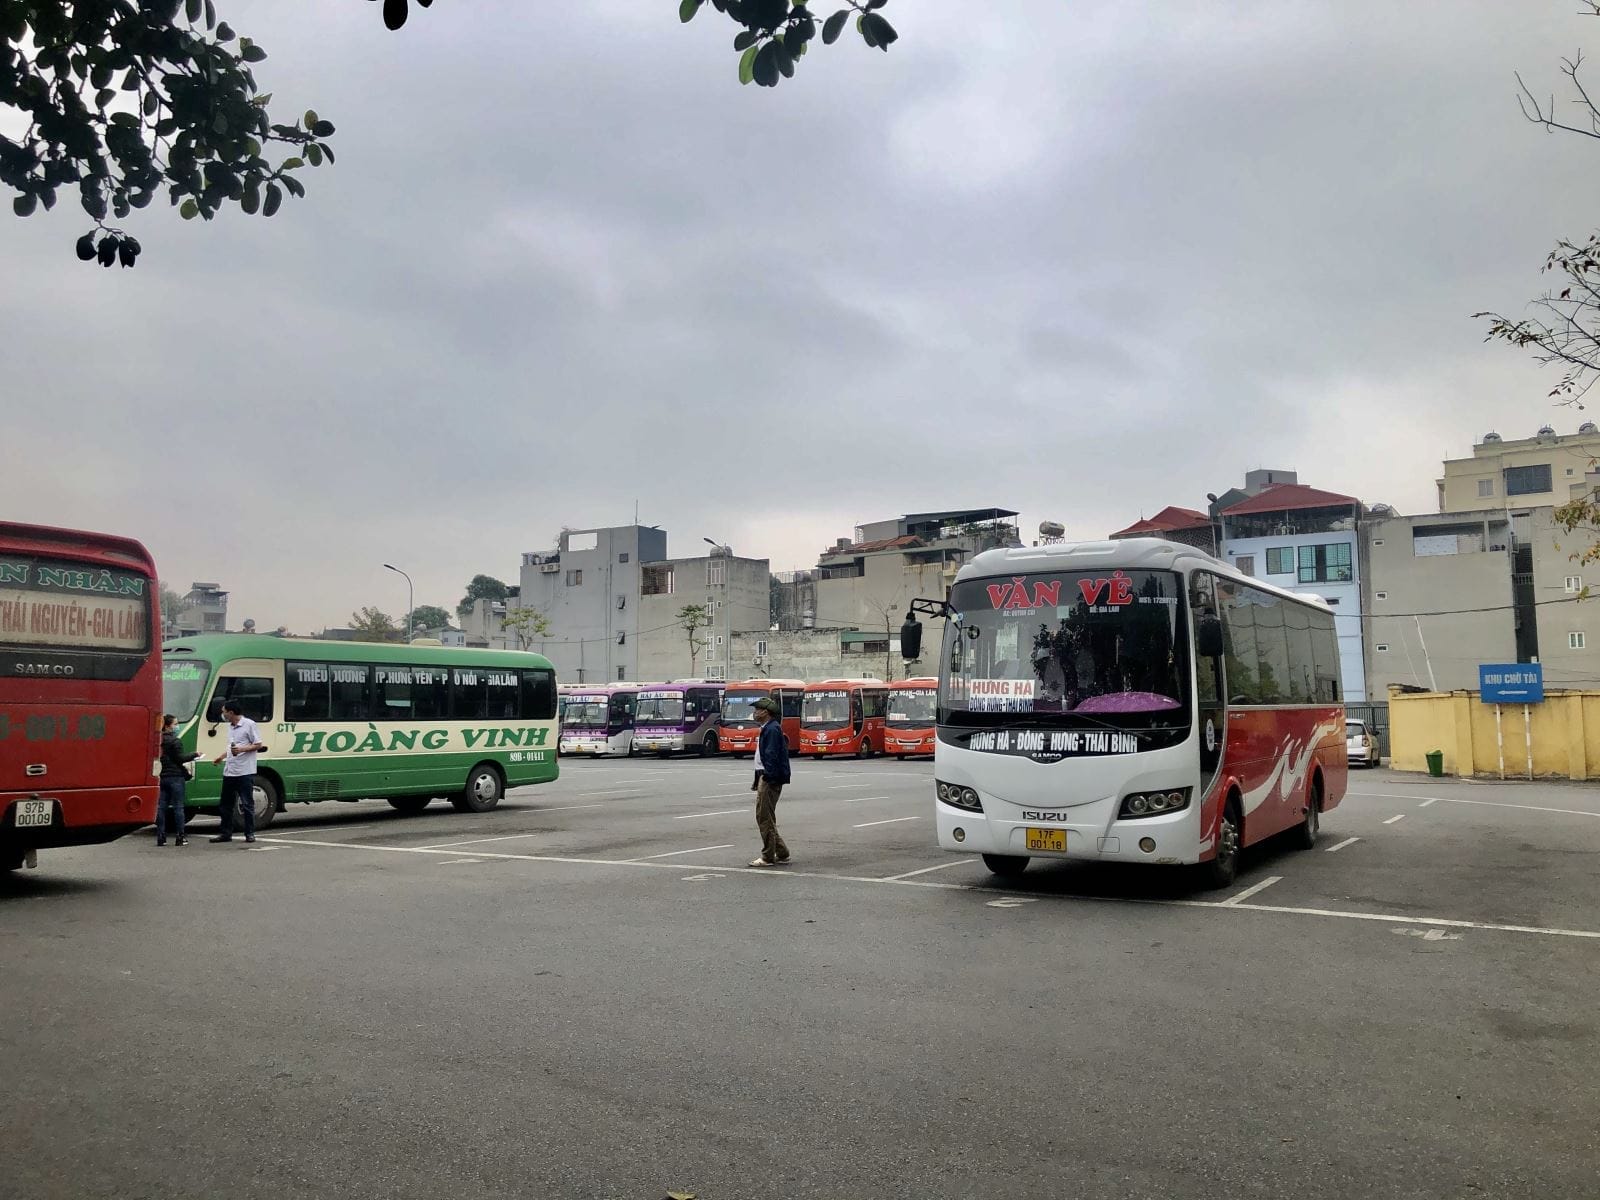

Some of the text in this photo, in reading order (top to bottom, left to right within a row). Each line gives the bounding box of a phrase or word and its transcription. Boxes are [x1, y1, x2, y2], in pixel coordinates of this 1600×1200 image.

[986, 570, 1134, 610] VĂN VẺ
[0, 595, 27, 633] HÁI
[415, 671, 433, 685] YÊN
[1484, 674, 1502, 685] KHU
[1523, 672, 1537, 684] TÀI
[972, 680, 1033, 695] HƯNG HÀ
[277, 722, 297, 733] CTY
[288, 722, 550, 754] HOÀNG VINH
[969, 732, 995, 750] HƯNG
[996, 730, 1010, 750] HÀ
[1017, 730, 1045, 751] ĐÔNG
[1084, 731, 1109, 752] THÁI
[1111, 731, 1138, 753] BÌNH
[25, 802, 45, 814] 97B
[1022, 811, 1067, 822] ISUZU
[1038, 830, 1055, 840] 17F
[1030, 839, 1062, 850] 001.18
